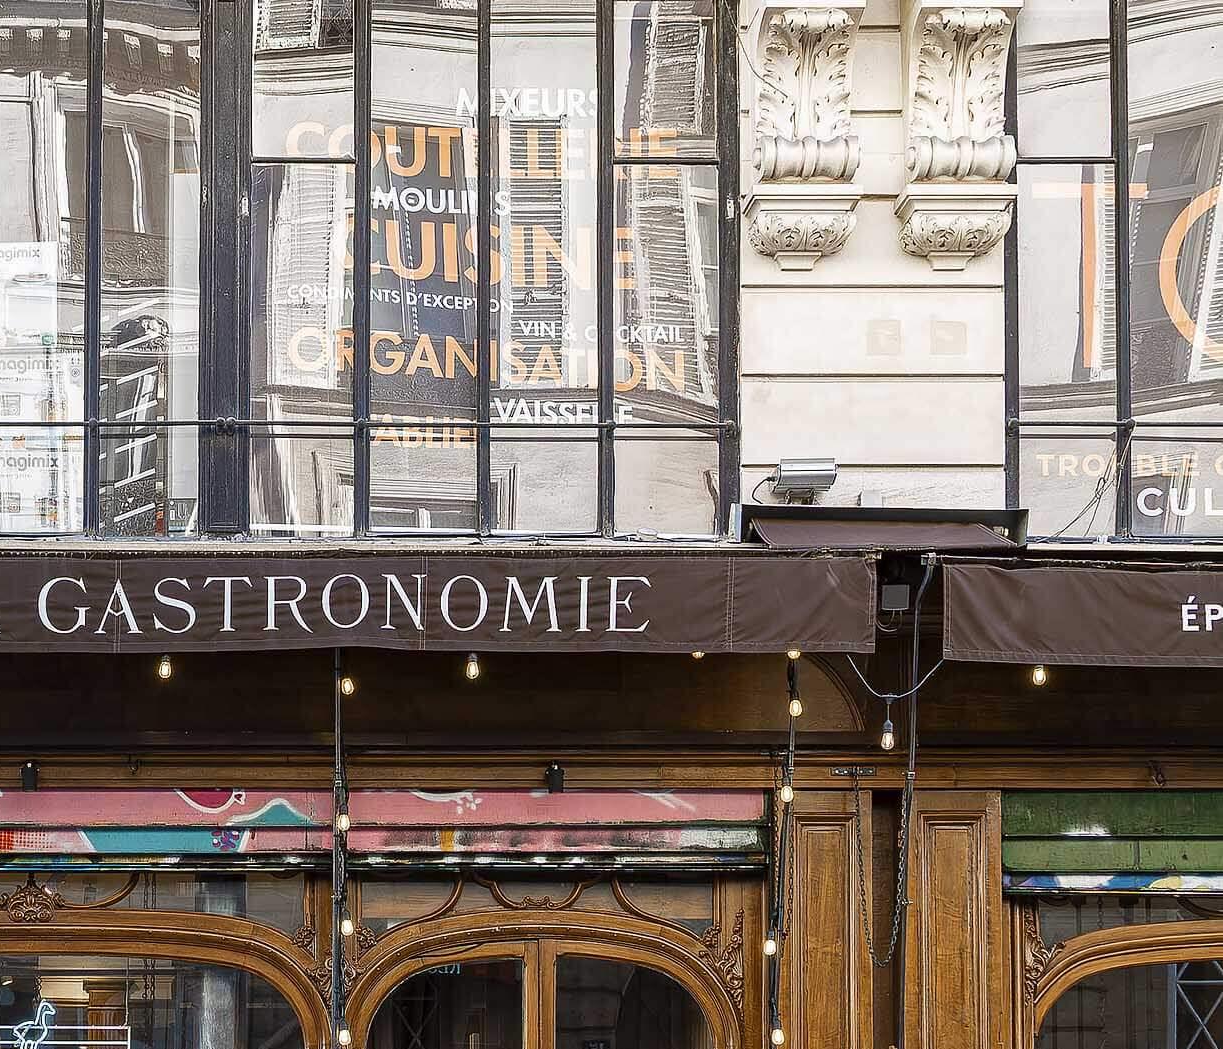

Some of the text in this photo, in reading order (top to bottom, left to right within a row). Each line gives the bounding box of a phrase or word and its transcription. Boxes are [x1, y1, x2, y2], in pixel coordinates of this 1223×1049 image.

[407, 290, 513, 313] D'EXCEPTON
[519, 319, 555, 338] VIN
[585, 324, 686, 343] CCKTAIL
[38, 572, 651, 634] GASTRONOMIE
